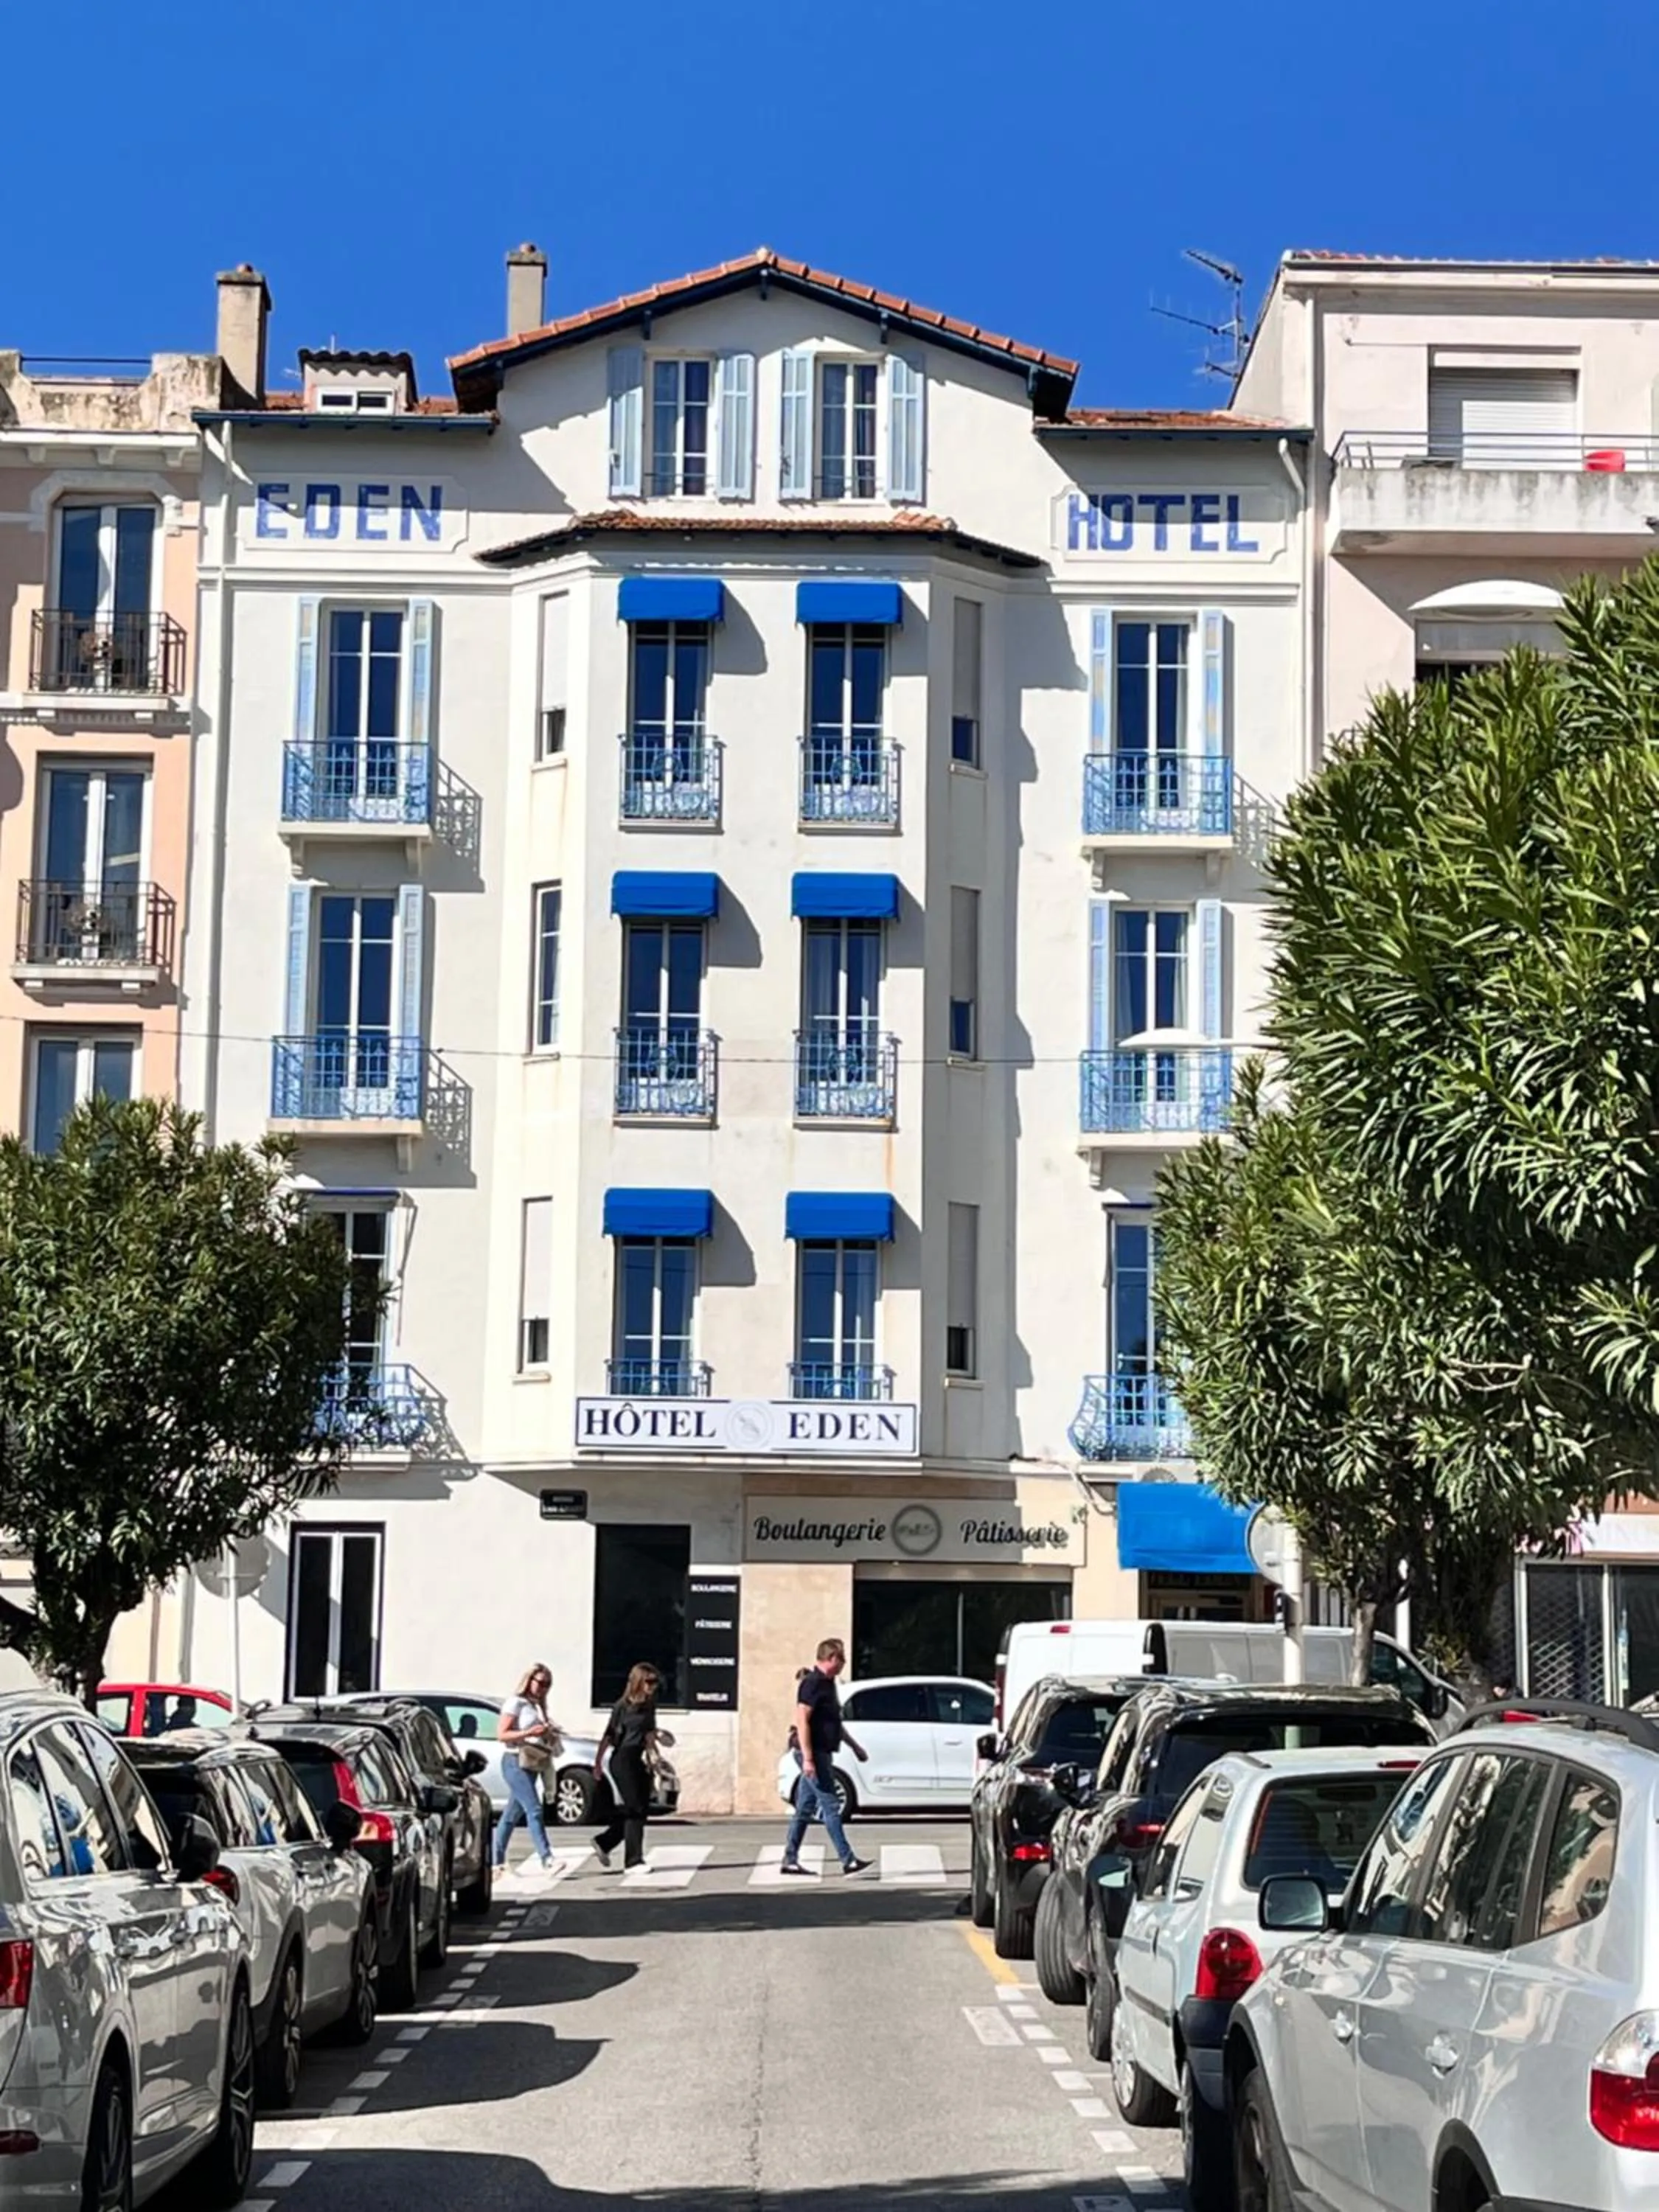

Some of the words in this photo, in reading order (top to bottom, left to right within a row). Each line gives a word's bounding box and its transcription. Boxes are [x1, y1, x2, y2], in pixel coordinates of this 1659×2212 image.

[256, 483, 442, 540] EDEN
[1068, 494, 1259, 552] HOTEL
[584, 1402, 716, 1438] HÔTEL
[788, 1411, 901, 1440] EDEN
[754, 1516, 886, 1548] Boulangerie
[961, 1520, 1068, 1548] Pâtisserie
